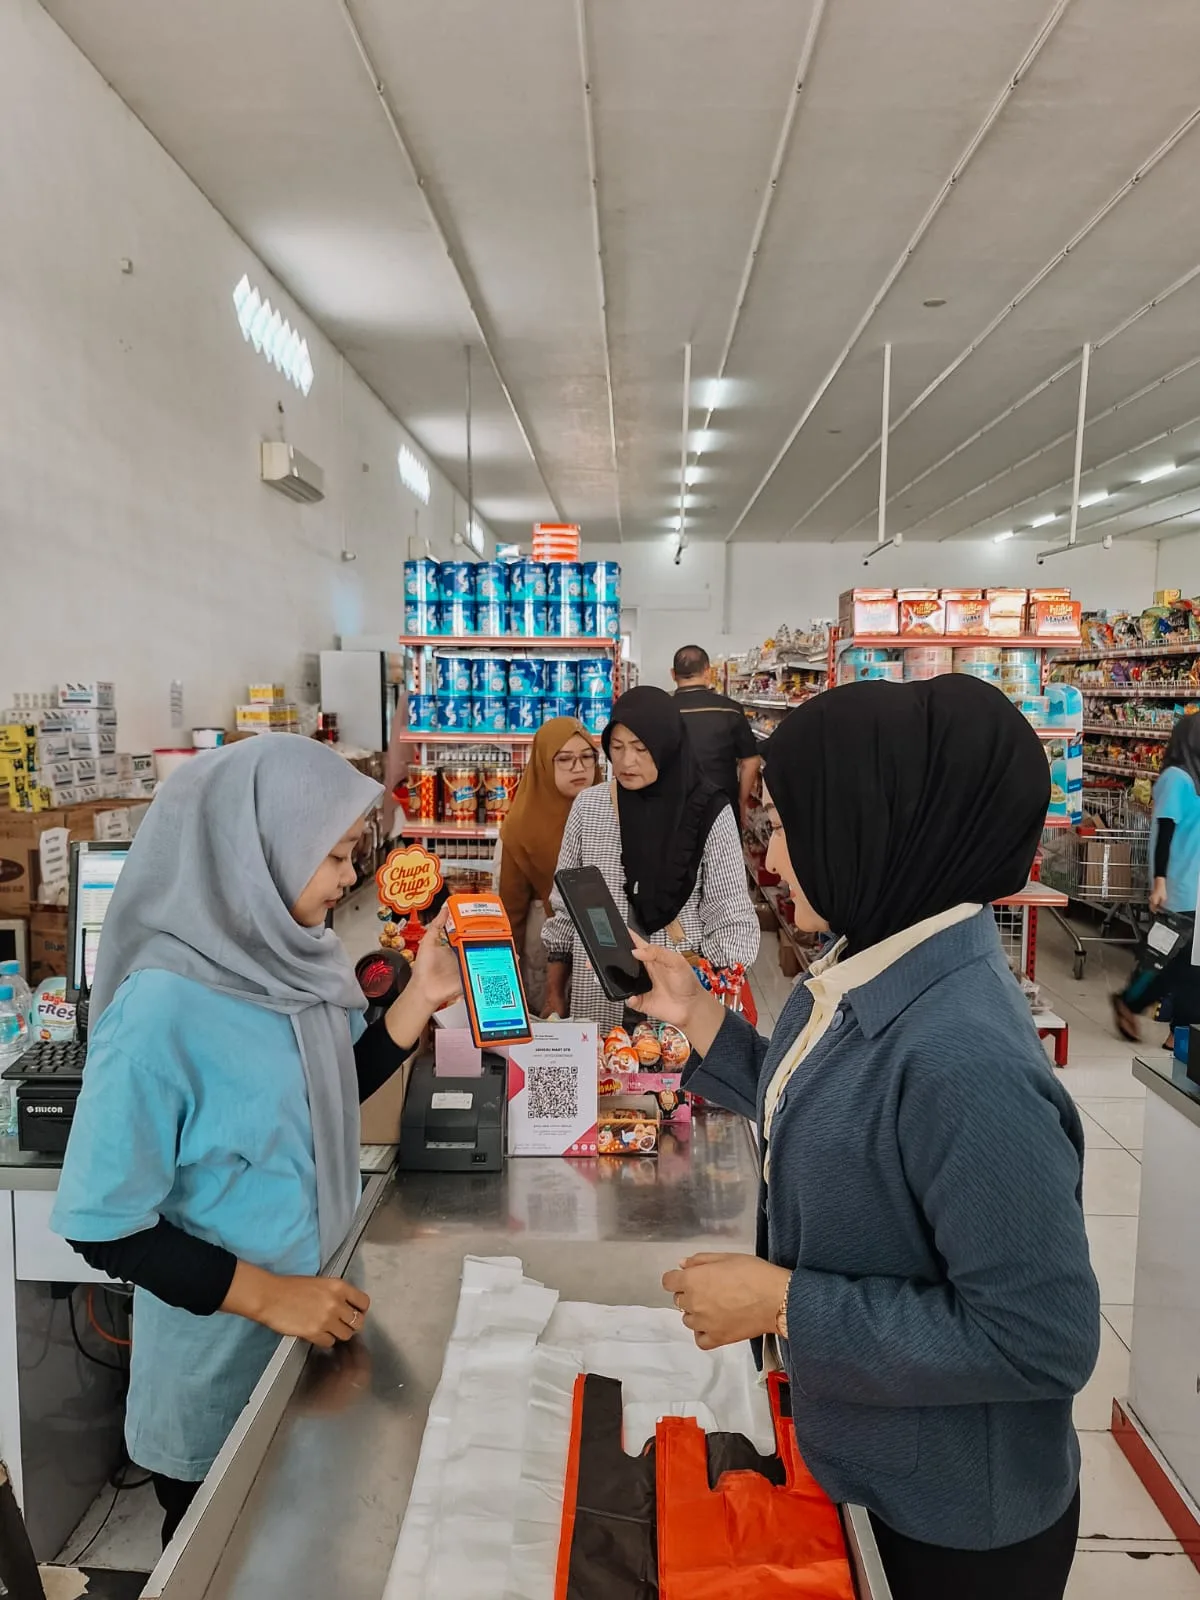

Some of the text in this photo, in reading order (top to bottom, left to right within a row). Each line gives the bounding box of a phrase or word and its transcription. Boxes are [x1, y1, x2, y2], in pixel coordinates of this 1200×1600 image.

[390, 863, 430, 881] Chupa
[389, 877, 430, 901] Chups
[42, 992, 66, 1005] Bagu
